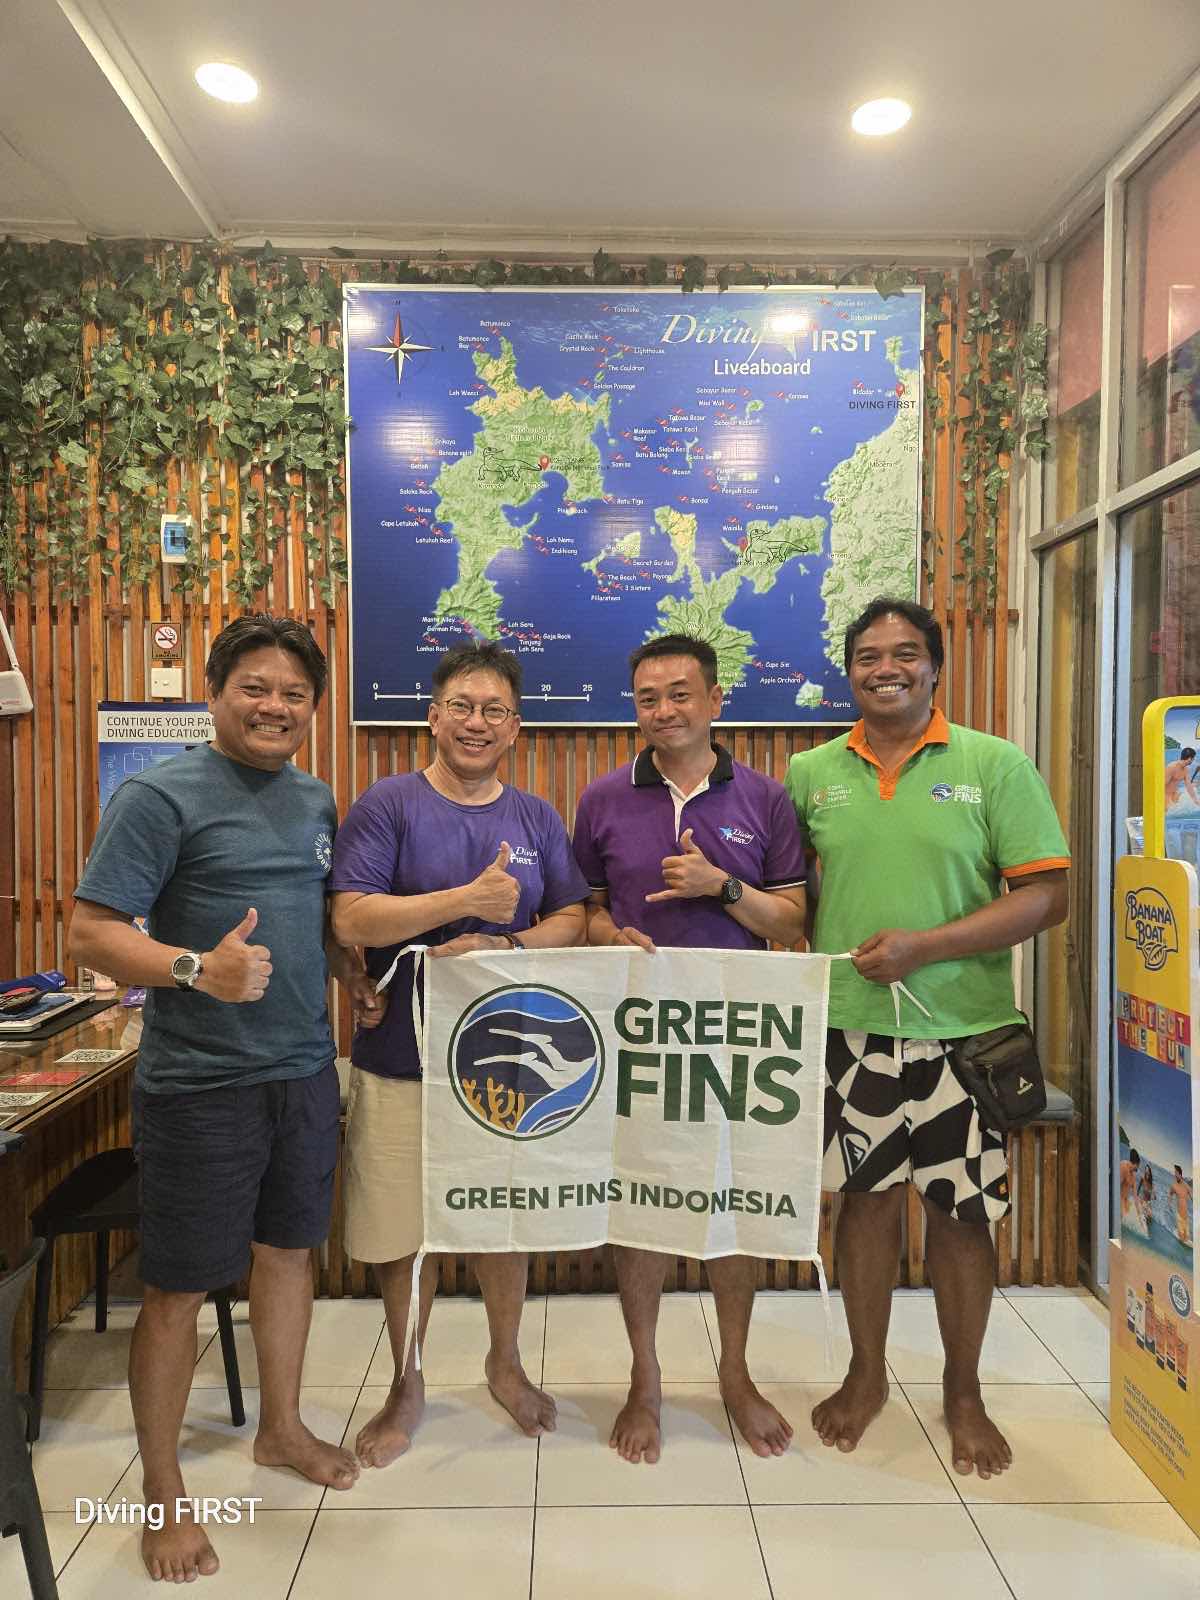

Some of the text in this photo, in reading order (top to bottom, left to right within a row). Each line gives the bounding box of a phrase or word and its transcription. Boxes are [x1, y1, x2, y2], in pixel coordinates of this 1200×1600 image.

[661, 314, 763, 364] Diving
[634, 347, 665, 355] Lighthouse
[714, 359, 811, 375] Liveaboard
[849, 401, 917, 409] DIVING FIRST
[541, 684, 551, 692] 20
[582, 684, 593, 692] 25
[107, 717, 162, 727] CONTINUE
[165, 717, 195, 727] YOUR
[107, 728, 209, 738] DIVING EDUCATION
[954, 784, 982, 793] GREEN
[954, 792, 982, 803] FINS
[726, 834, 746, 844] FIRST
[733, 828, 755, 844] Diving
[515, 846, 538, 858] Divin
[510, 853, 532, 865] FIRST
[1120, 996, 1185, 1038] PROTECT
[614, 997, 803, 1050] GREEN
[616, 1049, 803, 1126] FINS
[446, 1179, 797, 1218] GREEN FINS INDONESIA
